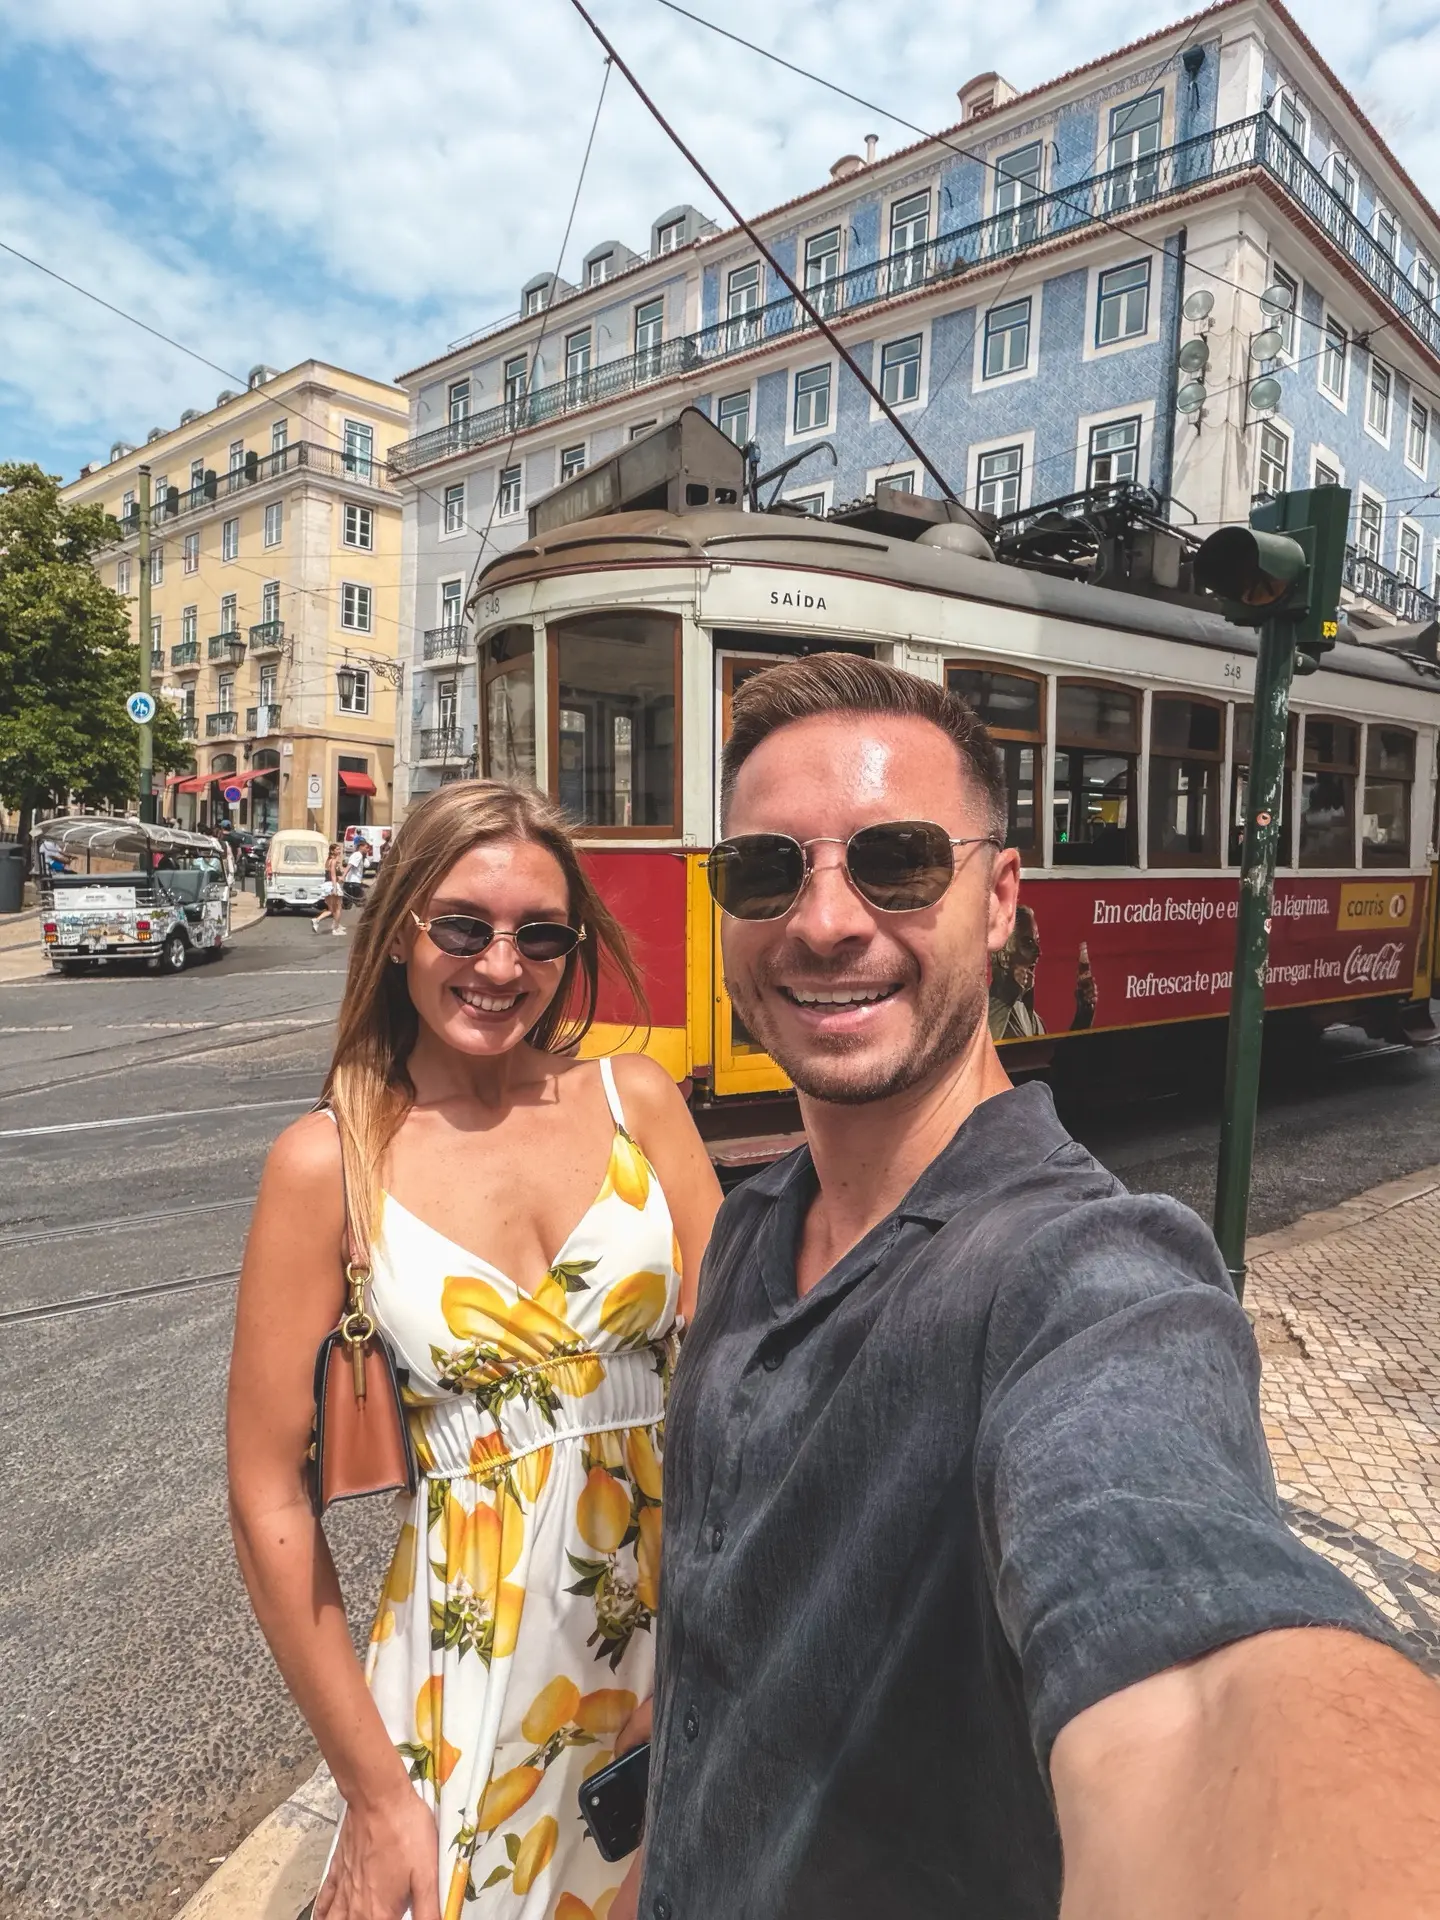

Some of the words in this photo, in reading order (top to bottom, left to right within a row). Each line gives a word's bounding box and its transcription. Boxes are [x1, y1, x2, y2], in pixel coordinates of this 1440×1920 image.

[484, 596, 500, 618] 548
[770, 589, 827, 610] SAÍDA
[1224, 663, 1241, 680] 548
[1093, 900, 1121, 924] Em
[1124, 897, 1161, 923] cada
[1164, 897, 1214, 925] festejo
[1216, 901, 1225, 919] e
[1284, 894, 1329, 920] lágrima.
[1347, 893, 1384, 917] carris
[1126, 970, 1209, 998] Refresca-te
[1313, 958, 1341, 979] Hora
